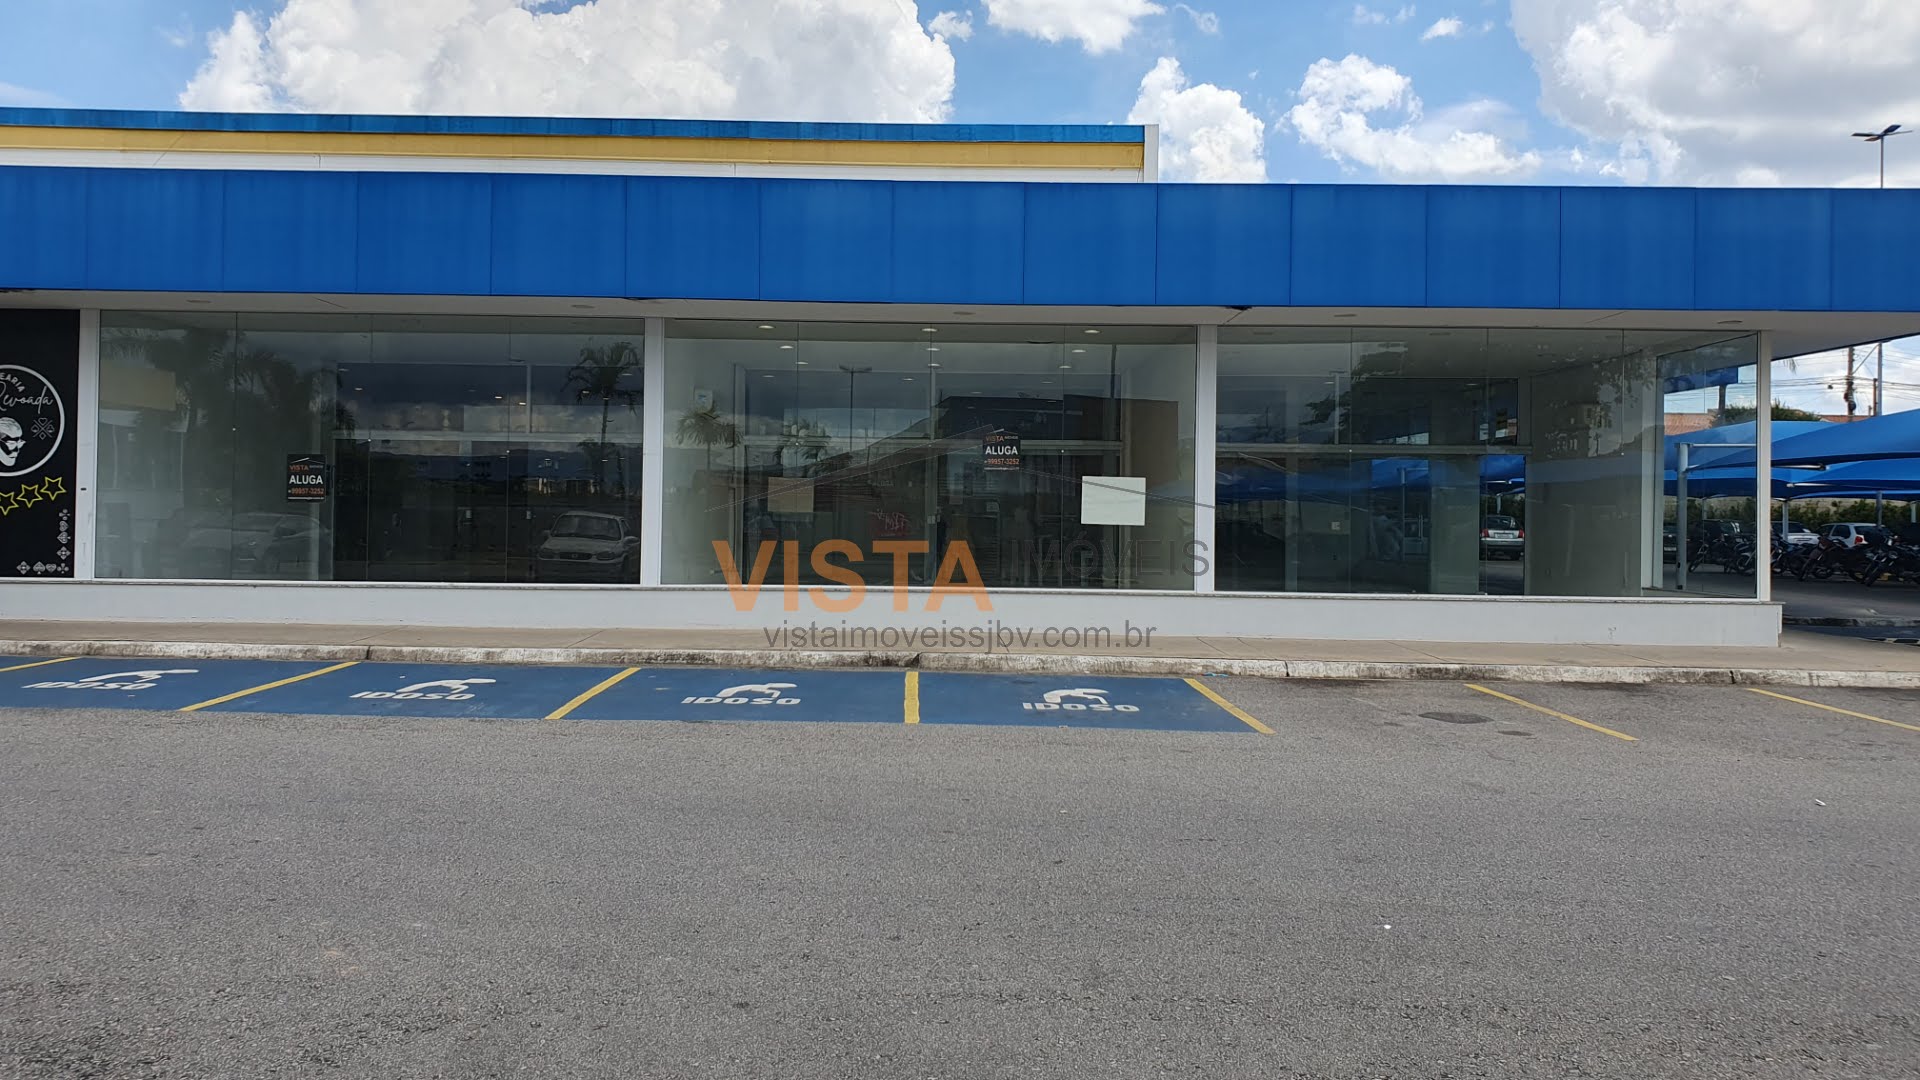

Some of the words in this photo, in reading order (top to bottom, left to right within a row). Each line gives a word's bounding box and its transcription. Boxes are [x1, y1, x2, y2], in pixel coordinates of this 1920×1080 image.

[985, 445, 1018, 455] ALUGA
[289, 474, 323, 485] ALUGA
[22, 681, 158, 691] IDOSO
[349, 691, 477, 700] IDOSO
[681, 696, 801, 706] IDOSO
[1022, 702, 1140, 712] IDOSO
